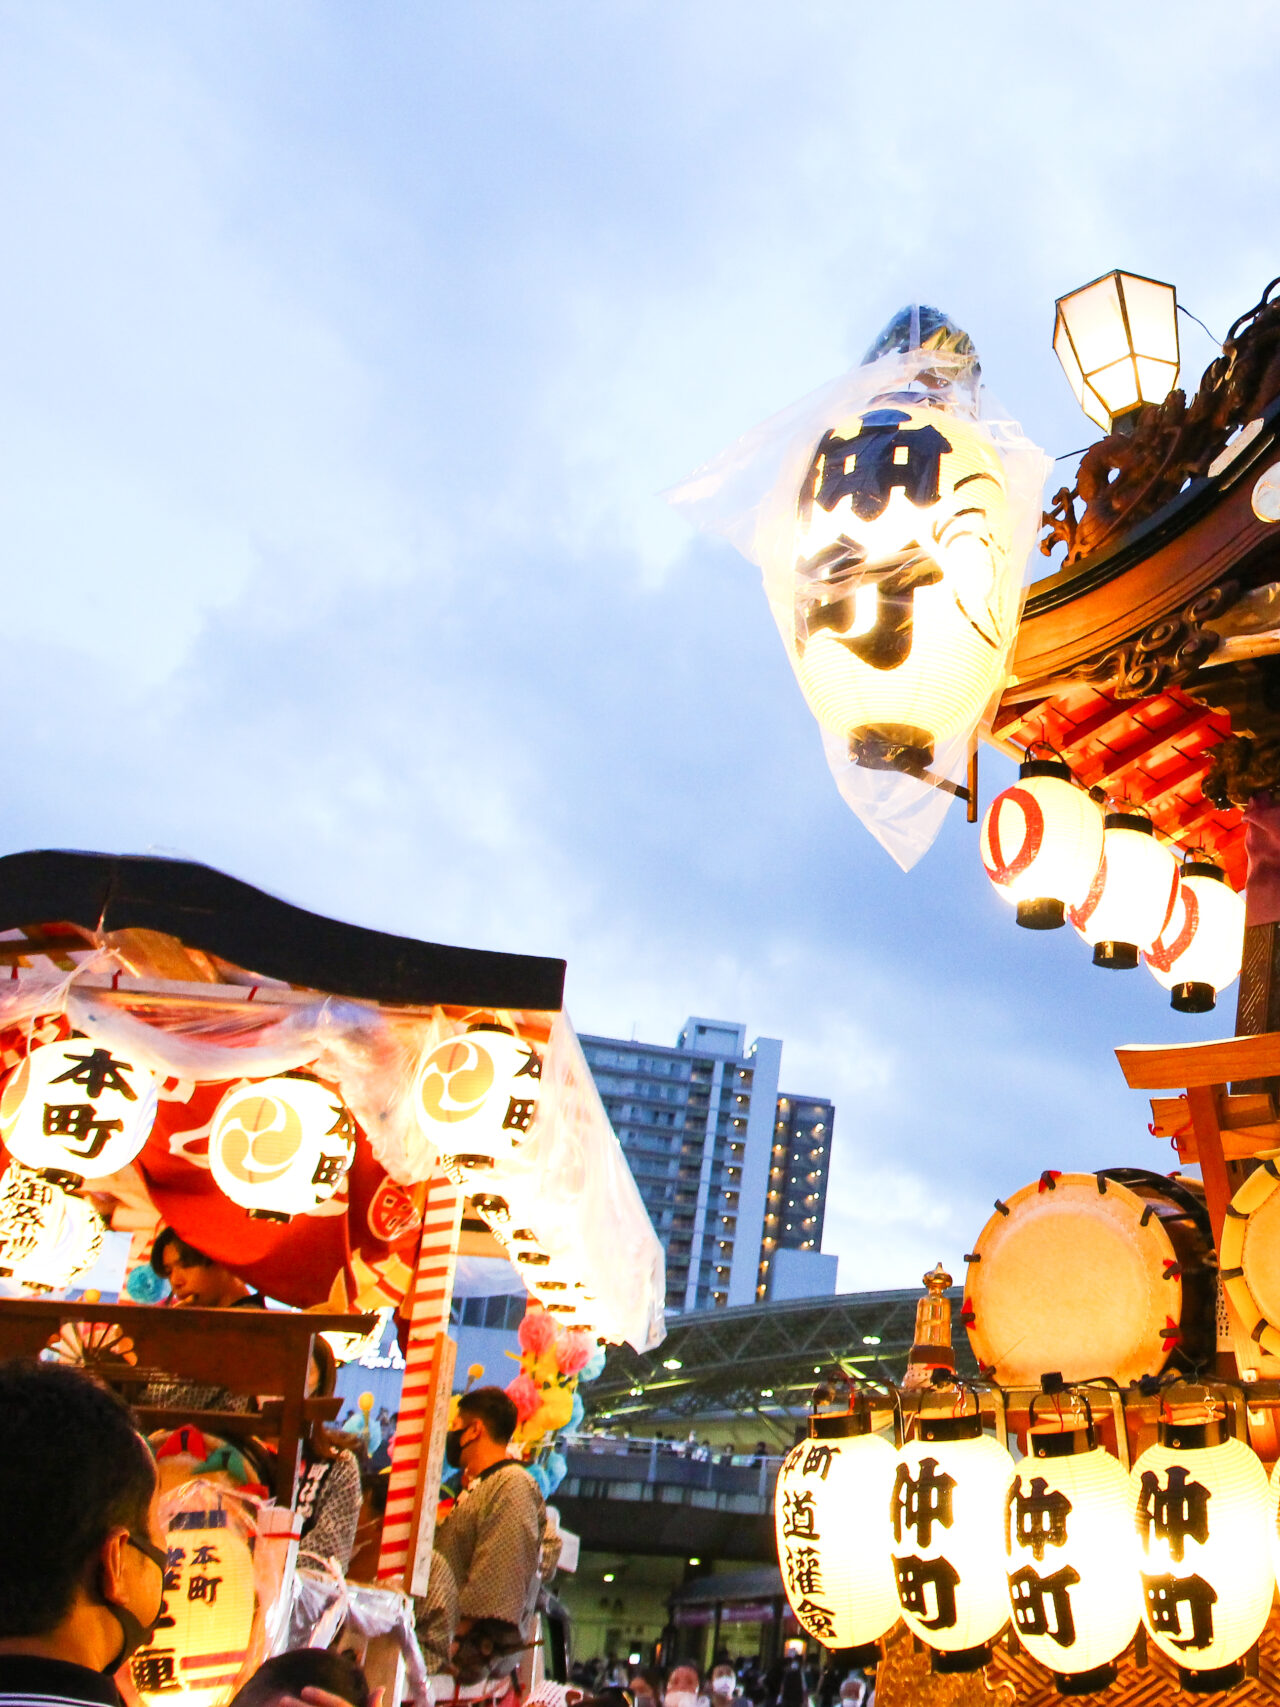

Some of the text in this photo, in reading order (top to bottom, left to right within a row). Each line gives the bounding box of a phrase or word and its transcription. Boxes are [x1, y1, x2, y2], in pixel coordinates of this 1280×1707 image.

[797, 409, 943, 671] 仲町
[42, 1049, 138, 1159] 本町
[188, 1546, 223, 1607] 本町
[890, 1458, 960, 1630] 仲町
[1006, 1477, 1080, 1648] 仲町
[1135, 1466, 1218, 1651] 仲町
